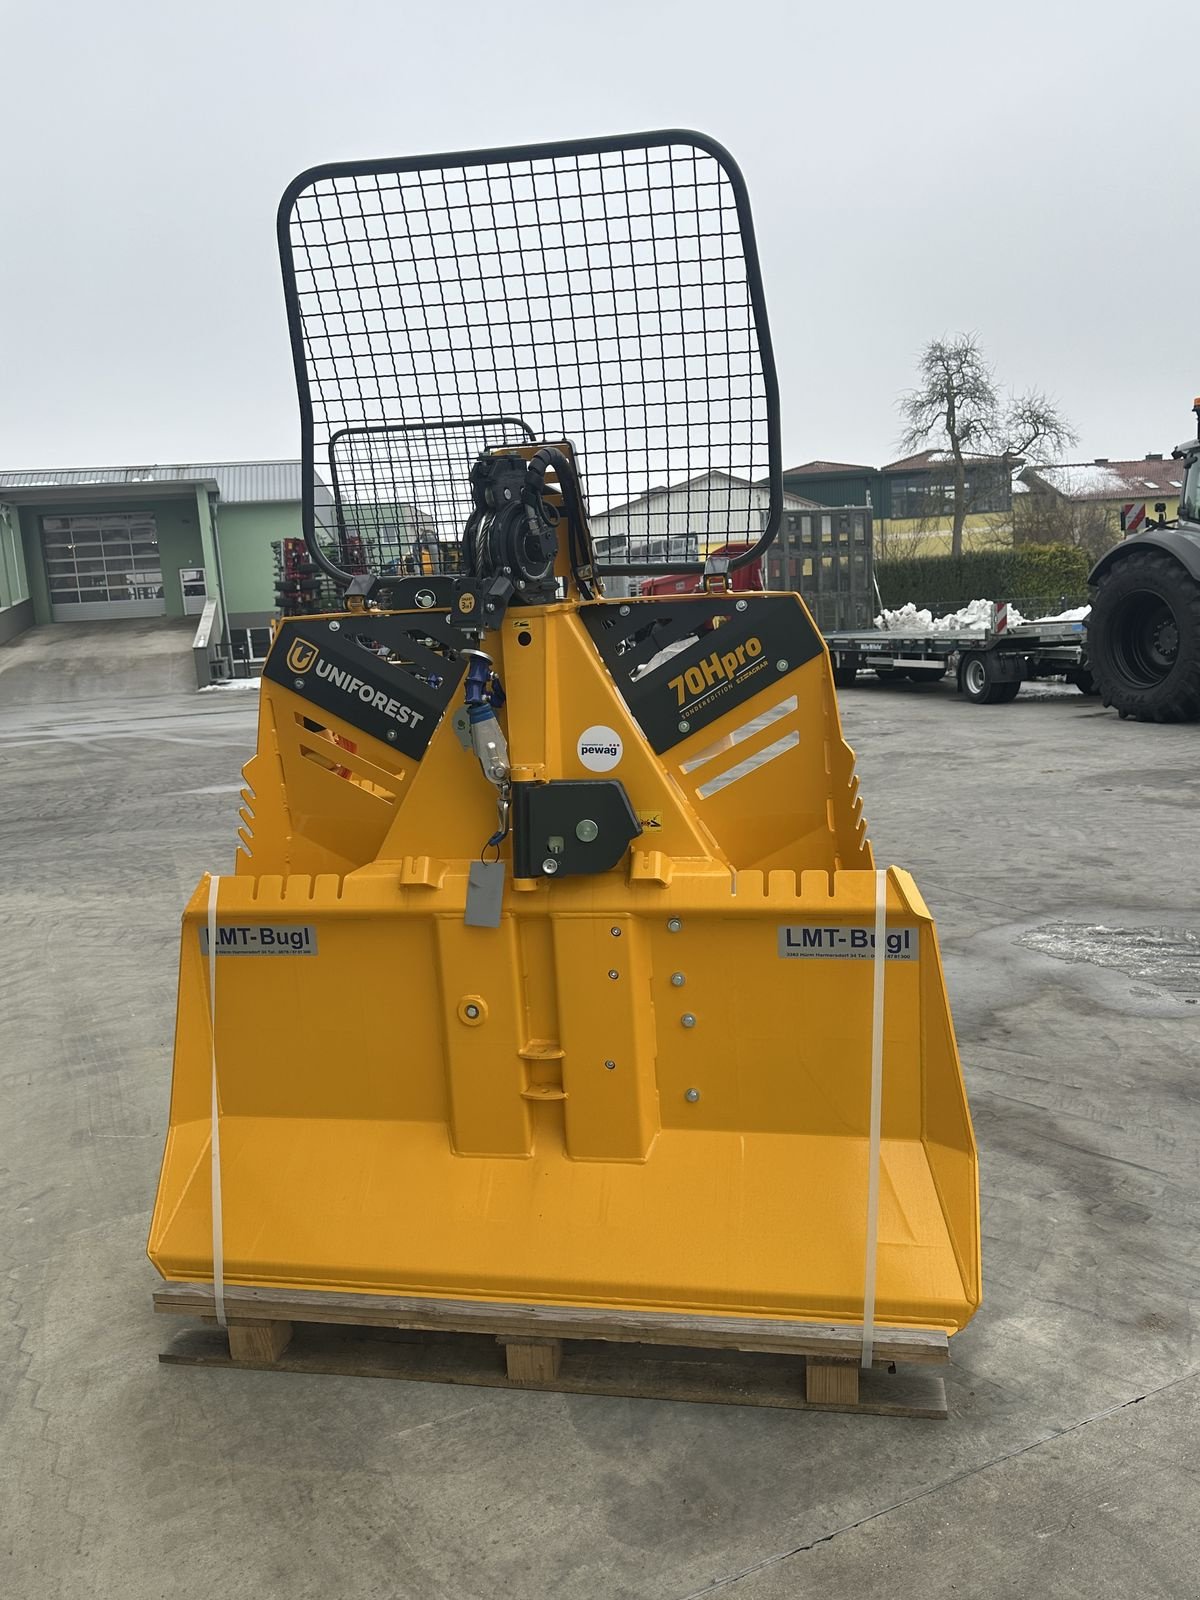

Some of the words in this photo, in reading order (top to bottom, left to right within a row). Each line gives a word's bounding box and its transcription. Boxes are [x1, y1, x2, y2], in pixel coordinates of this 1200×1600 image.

[315, 658, 424, 729] UNIFOREST
[667, 637, 762, 706] 70Hpro
[581, 746, 617, 756] pewag
